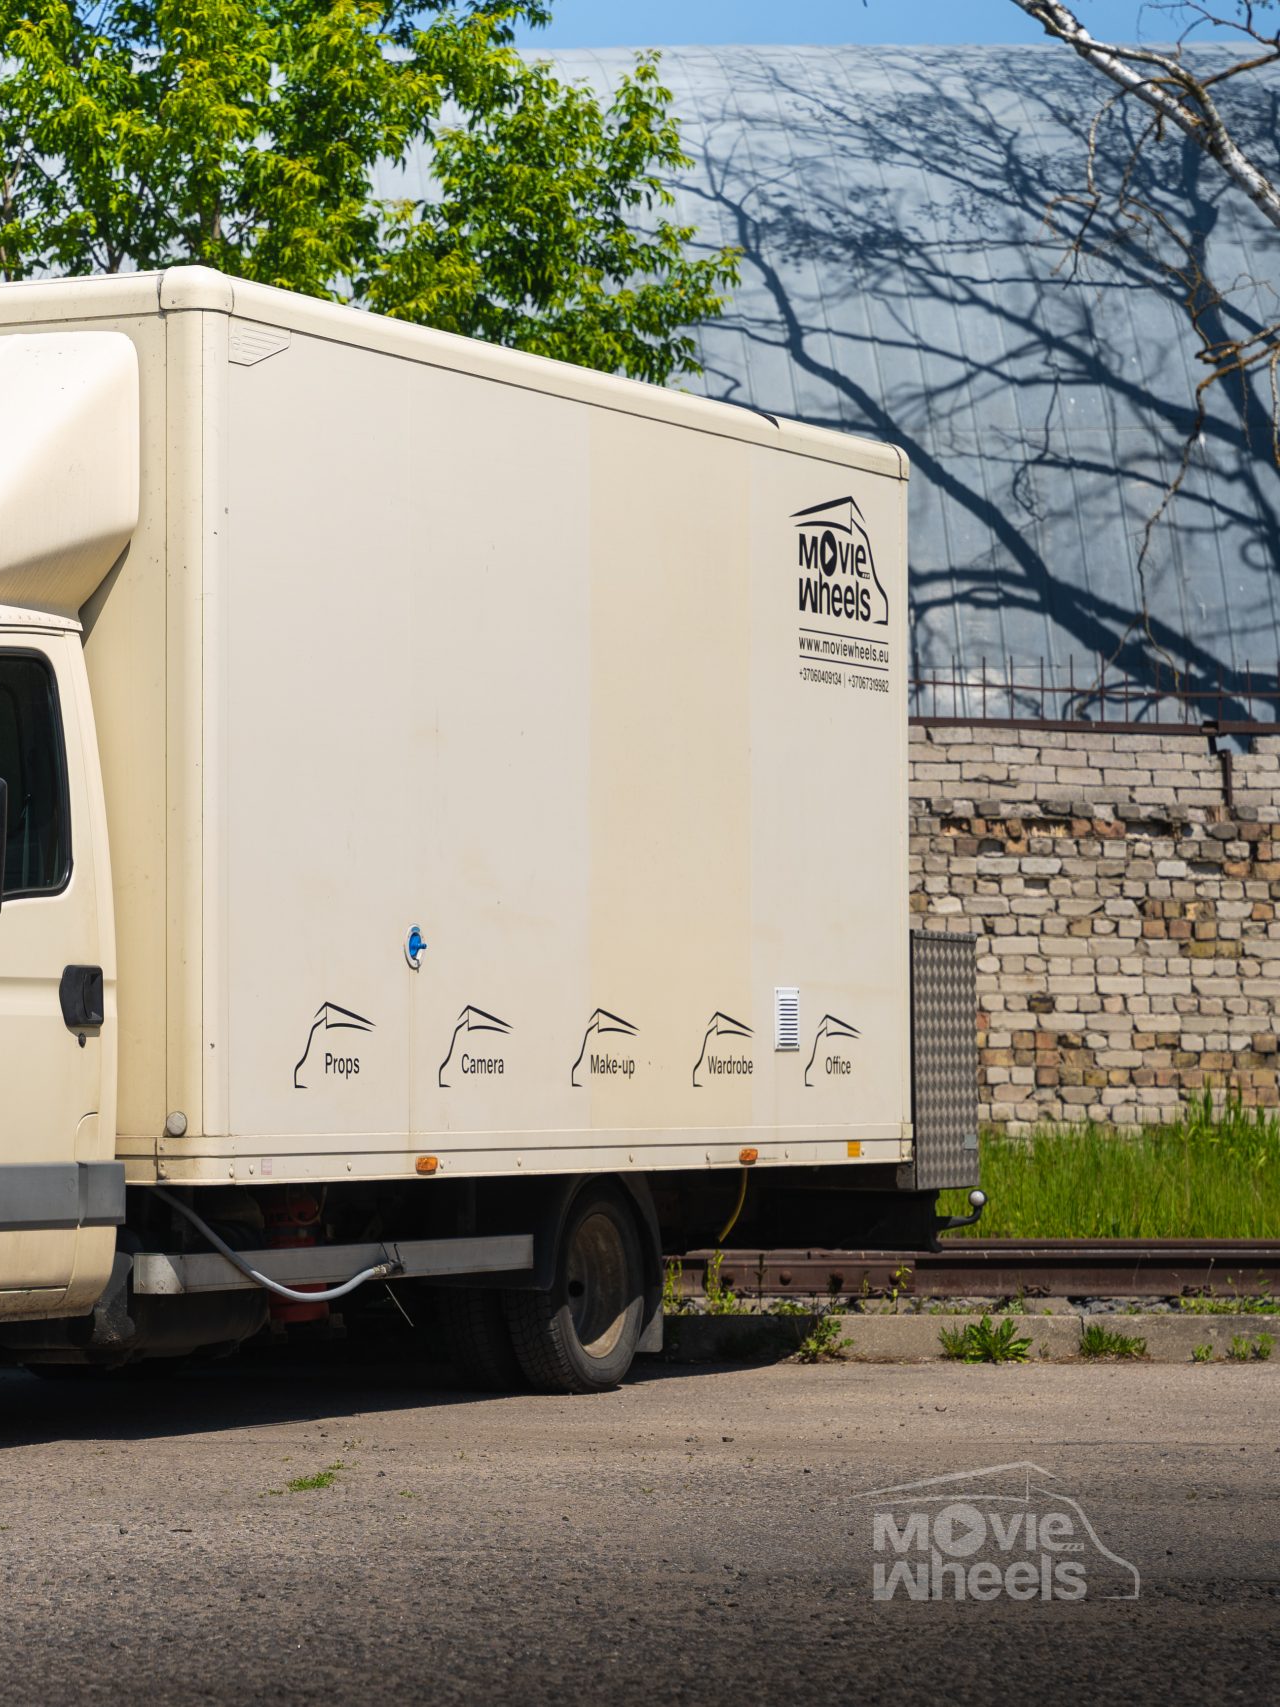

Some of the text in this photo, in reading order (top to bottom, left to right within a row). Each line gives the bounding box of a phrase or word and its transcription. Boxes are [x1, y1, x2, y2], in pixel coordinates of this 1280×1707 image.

[799, 636, 889, 664] www.moviewheels.eu
[325, 1053, 360, 1079] Props
[461, 1053, 504, 1074] Camera
[590, 1054, 635, 1079] Make-up
[707, 1055, 753, 1075] Wardrobe
[825, 1056, 851, 1075] Office
